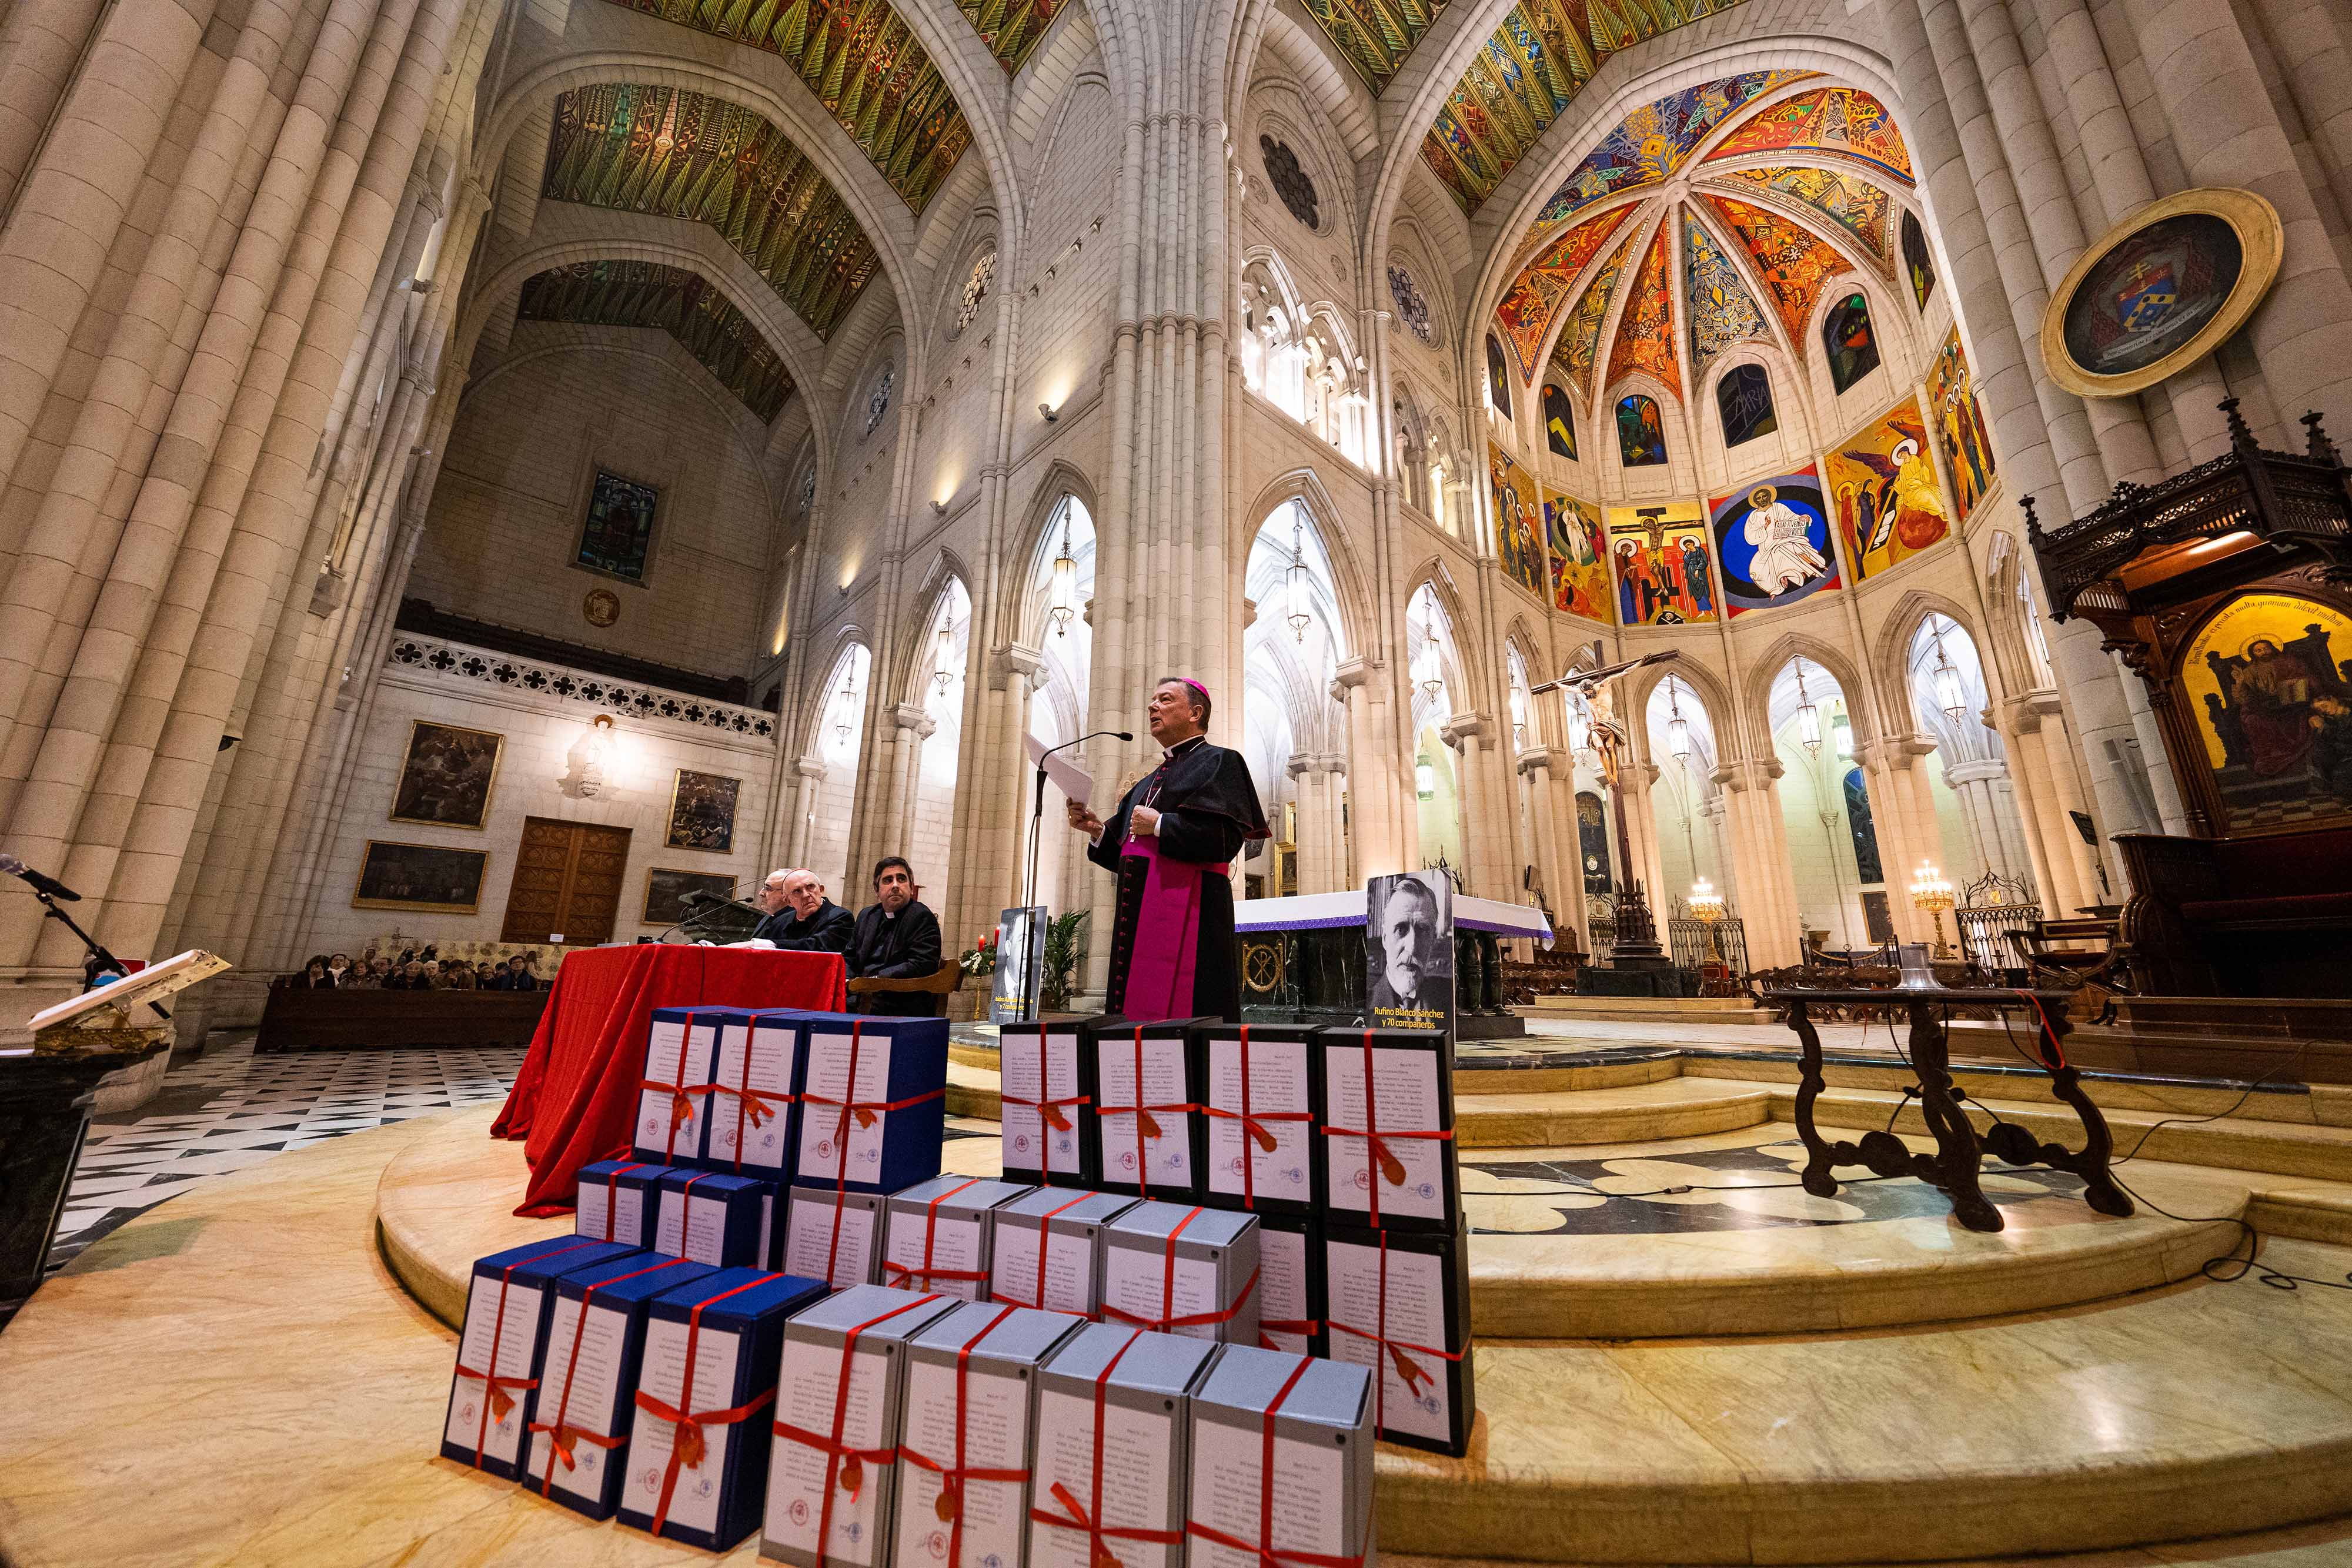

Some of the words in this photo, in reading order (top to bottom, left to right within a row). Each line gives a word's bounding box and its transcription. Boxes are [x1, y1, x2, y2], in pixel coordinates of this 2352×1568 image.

[1374, 1007, 1394, 1015] Rufino
[1395, 1008, 1416, 1017] Blanco
[1417, 1008, 1444, 1018] Sánchez
[1387, 1018, 1395, 1026] 70
[1395, 1019, 1435, 1029] compañeros
